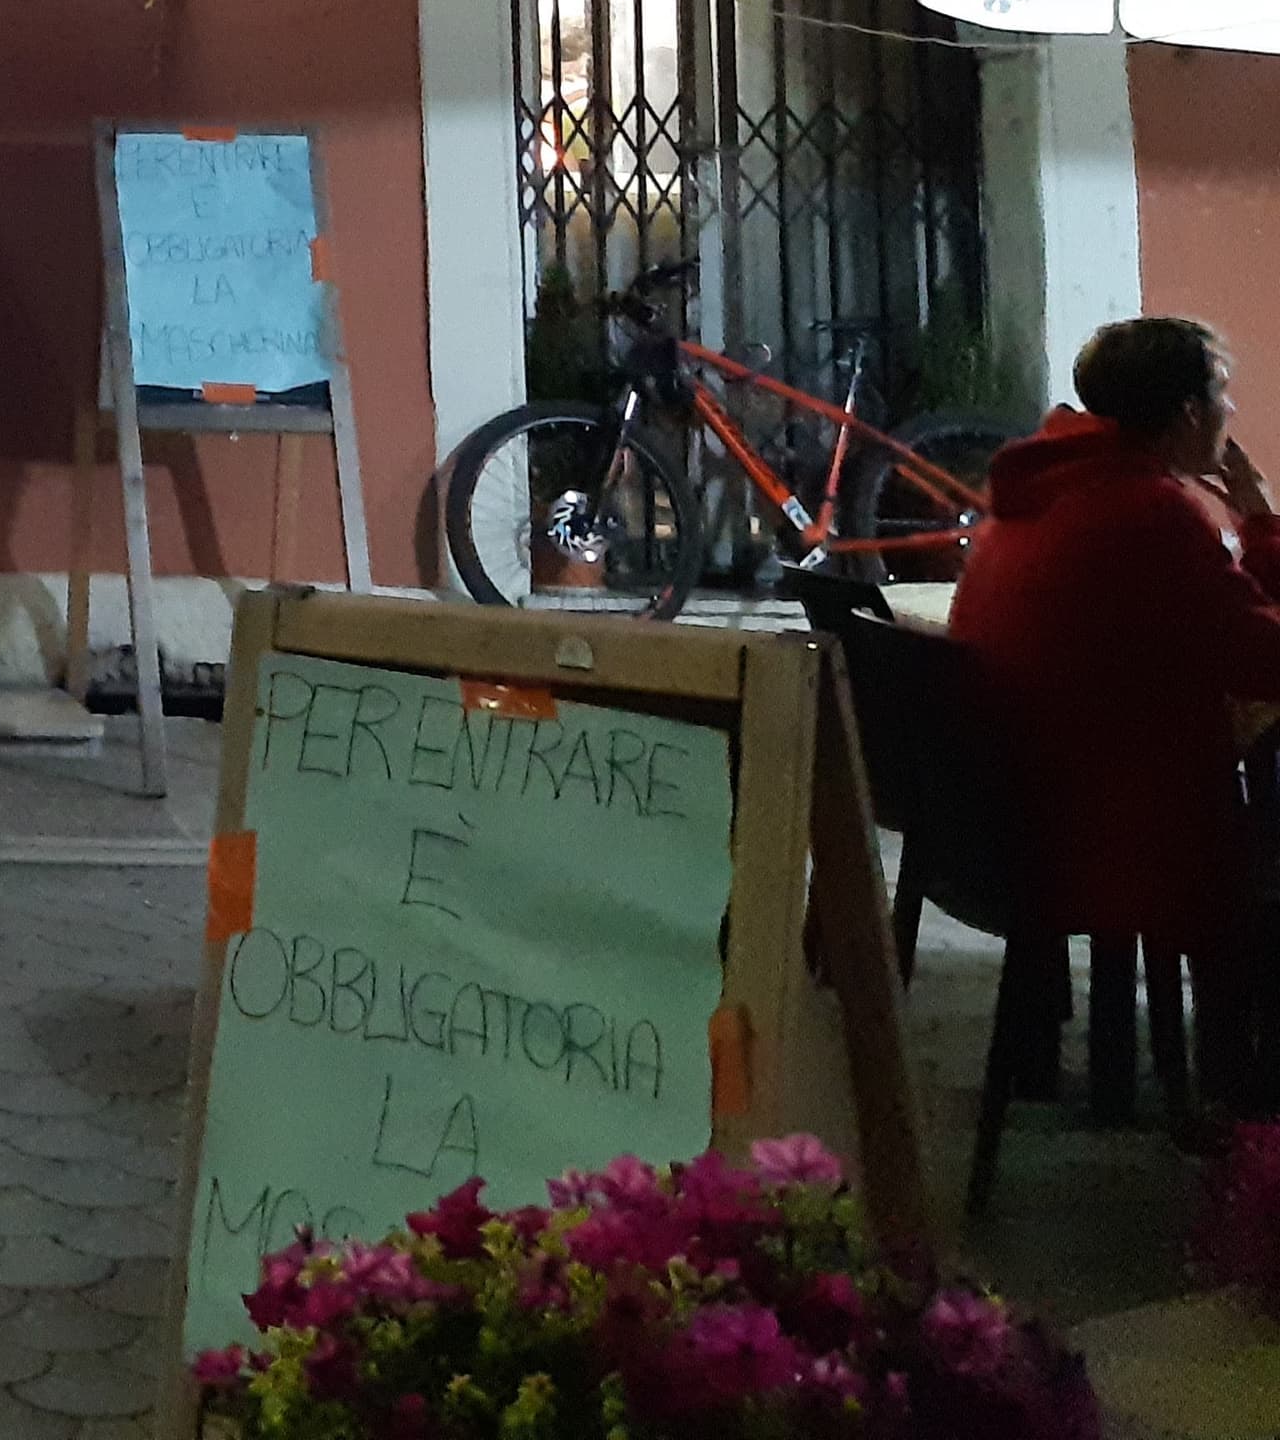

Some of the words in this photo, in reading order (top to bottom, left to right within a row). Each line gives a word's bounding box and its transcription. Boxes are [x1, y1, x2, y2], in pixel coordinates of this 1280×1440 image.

[192, 273, 238, 306] LA
[258, 671, 401, 780] PER
[408, 694, 691, 820] ENTRARE
[229, 926, 664, 1099] OBBLIGATORIA
[371, 1073, 481, 1178] LA
